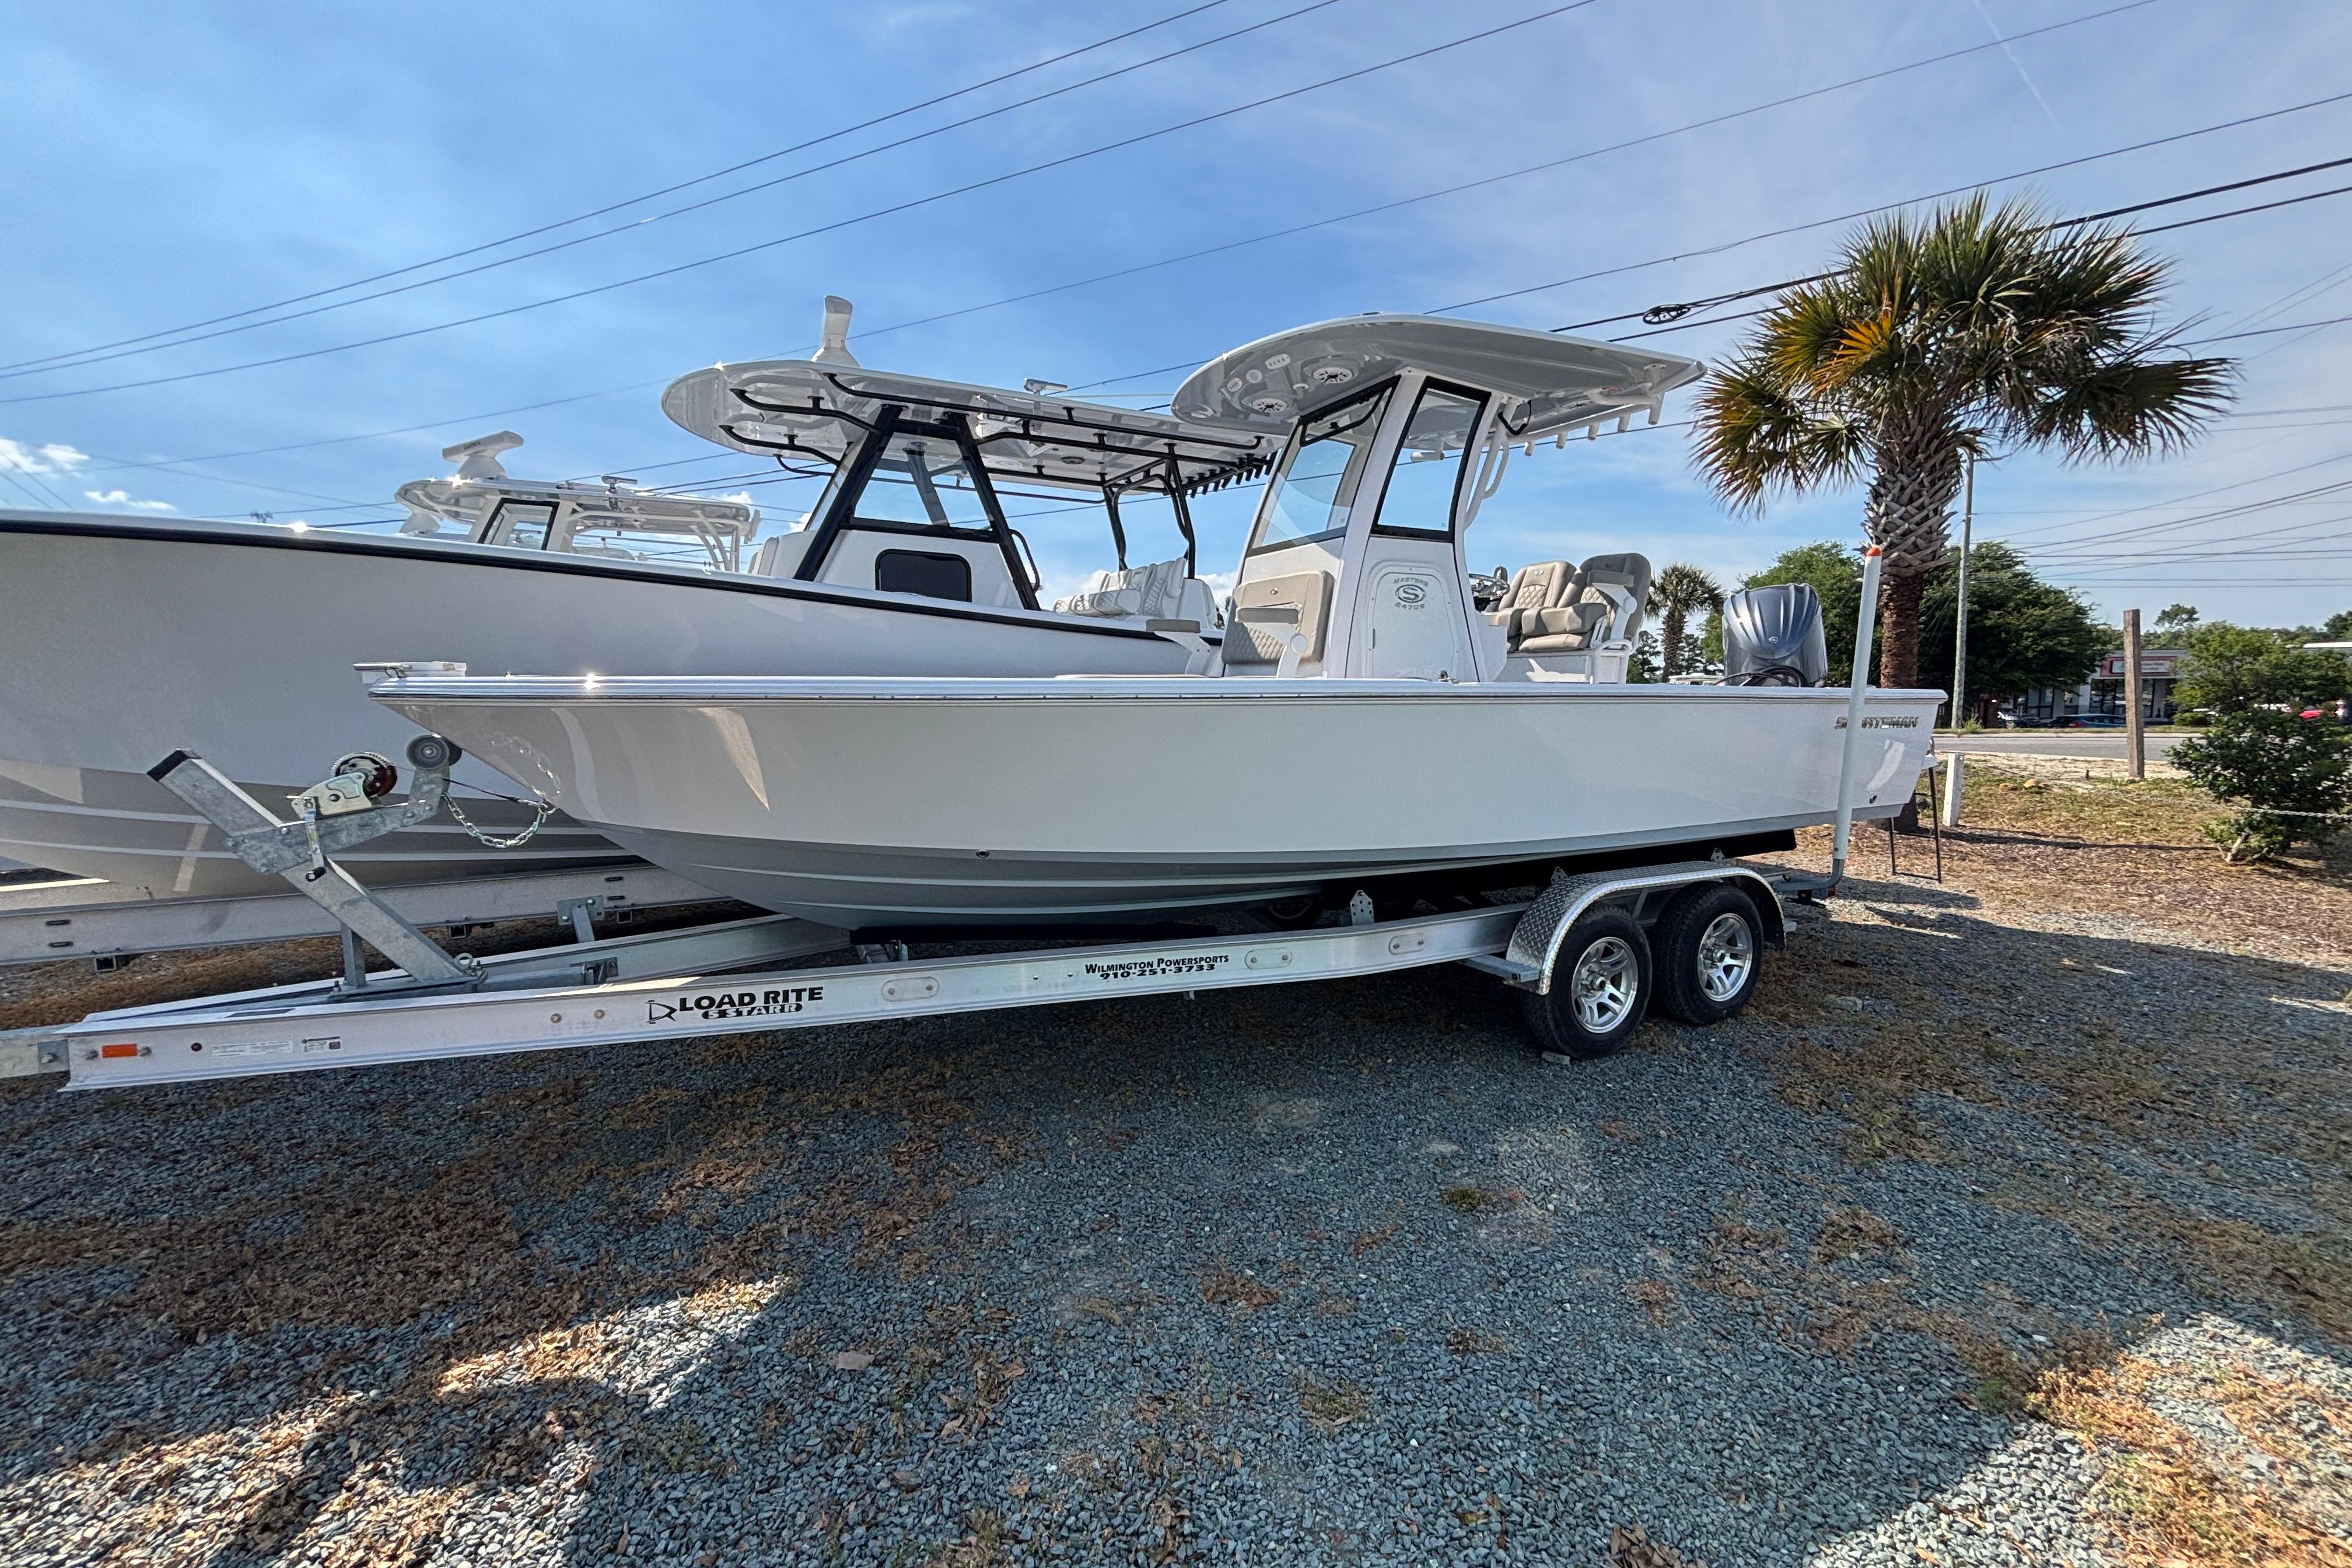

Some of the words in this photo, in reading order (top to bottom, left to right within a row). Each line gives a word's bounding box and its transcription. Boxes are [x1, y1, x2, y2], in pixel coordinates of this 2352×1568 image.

[1086, 960, 1154, 974] WILMINGTON
[1157, 955, 1229, 968] POWERSPORTS
[1100, 964, 1216, 980] 910-251-3733
[679, 992, 756, 1012] LOAD
[764, 986, 824, 1005] RITE
[707, 1010, 720, 1019] 5
[726, 1003, 798, 1017] STARR
